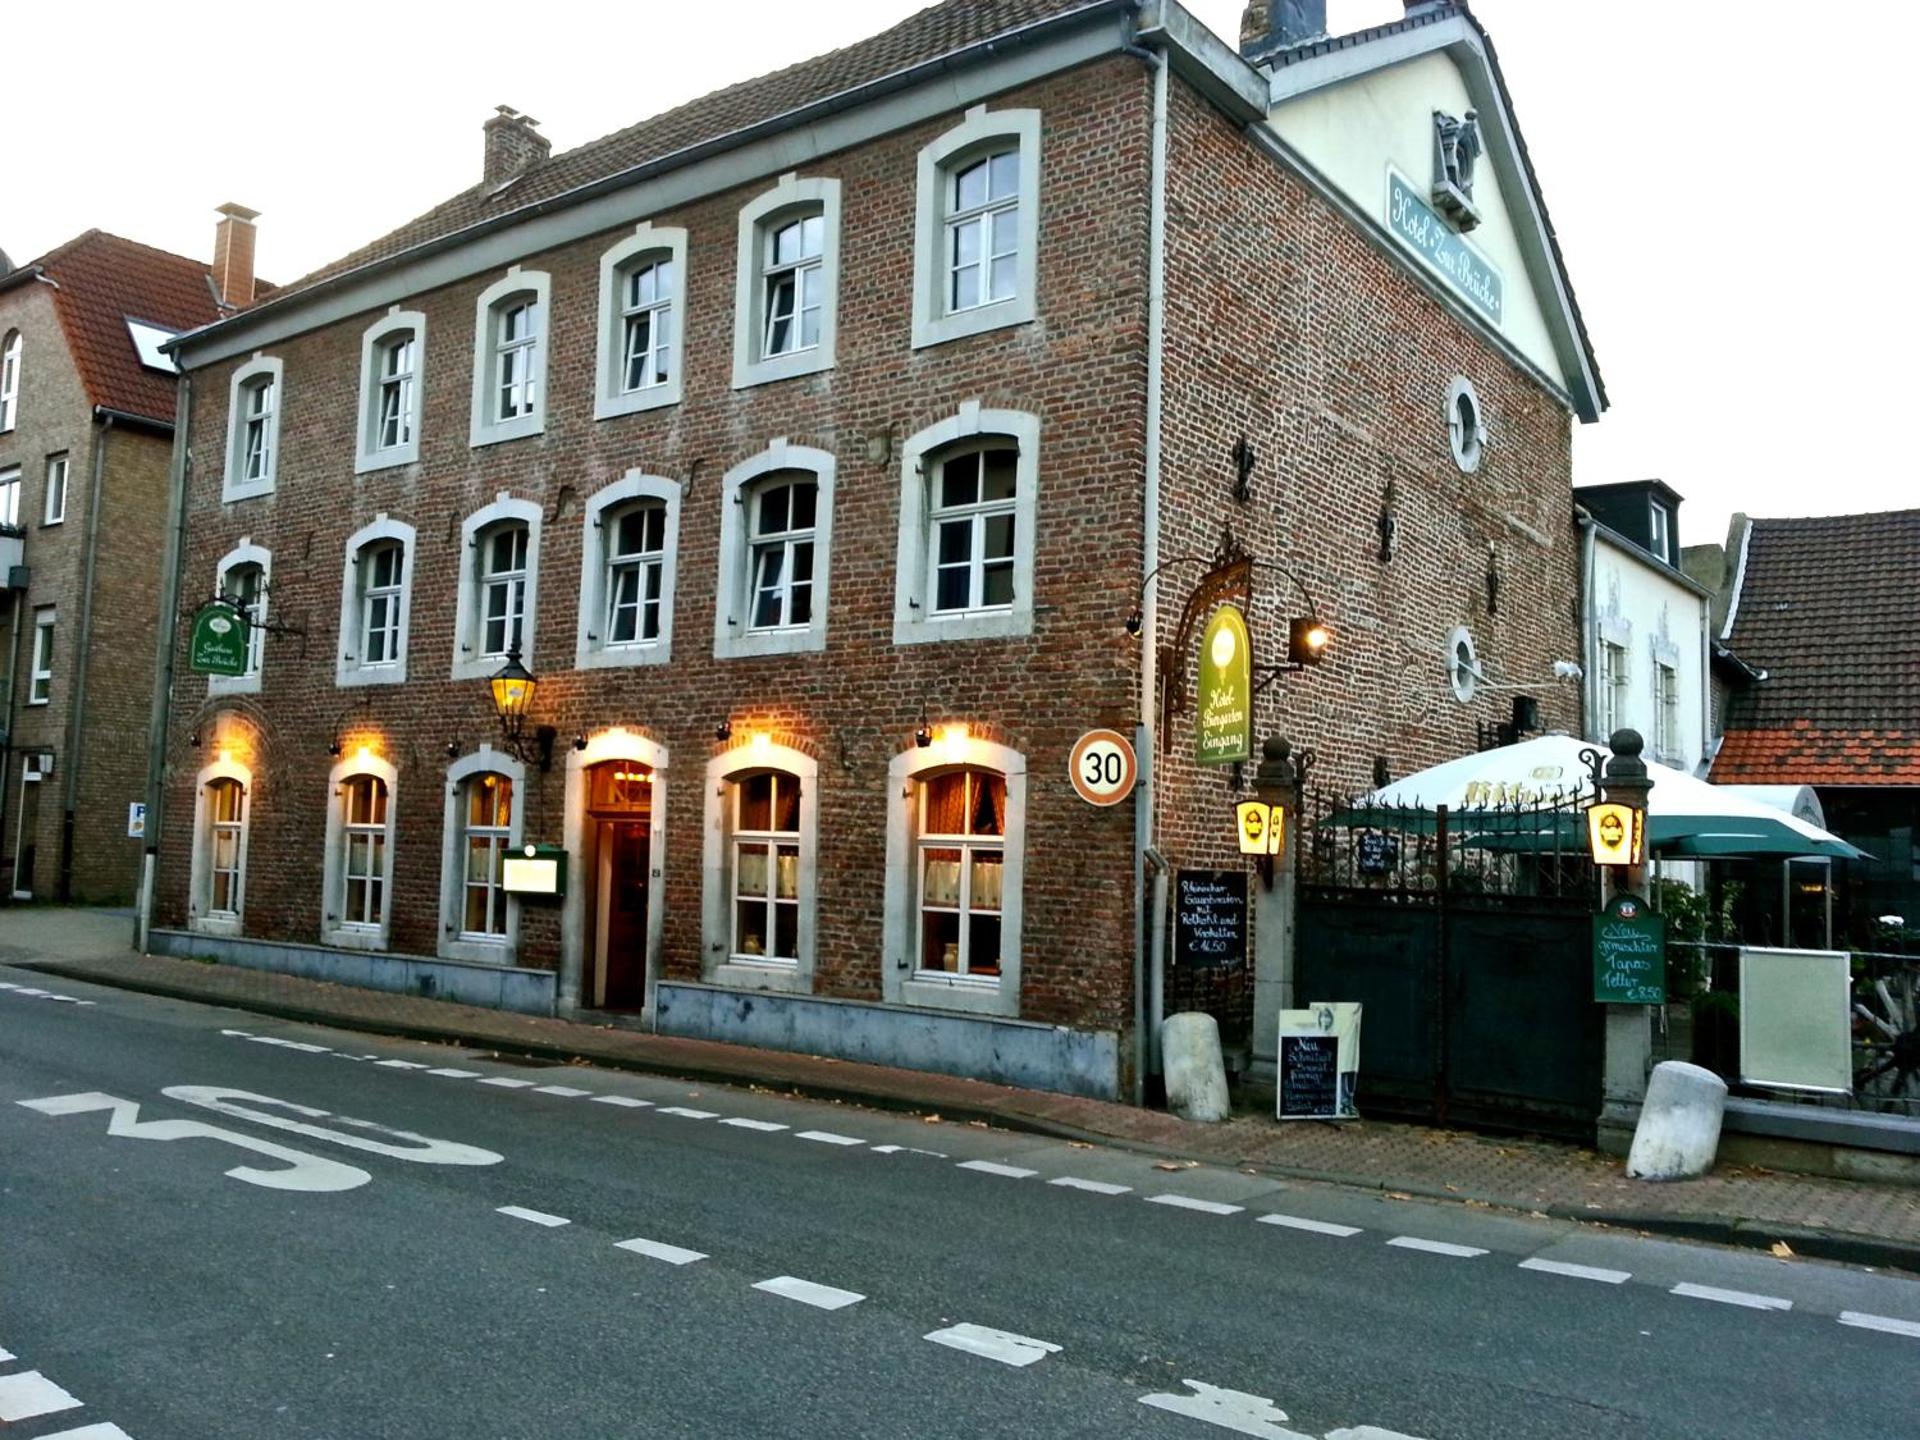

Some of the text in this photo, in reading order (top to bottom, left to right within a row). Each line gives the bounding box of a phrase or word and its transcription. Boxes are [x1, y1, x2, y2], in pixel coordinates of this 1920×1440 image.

[1393, 187, 1430, 247] Hotel
[1202, 730, 1243, 755] Eingang
[1085, 752, 1121, 785] 30
[1606, 952, 1651, 974] Tapas
[15, 1085, 505, 1192] 30
